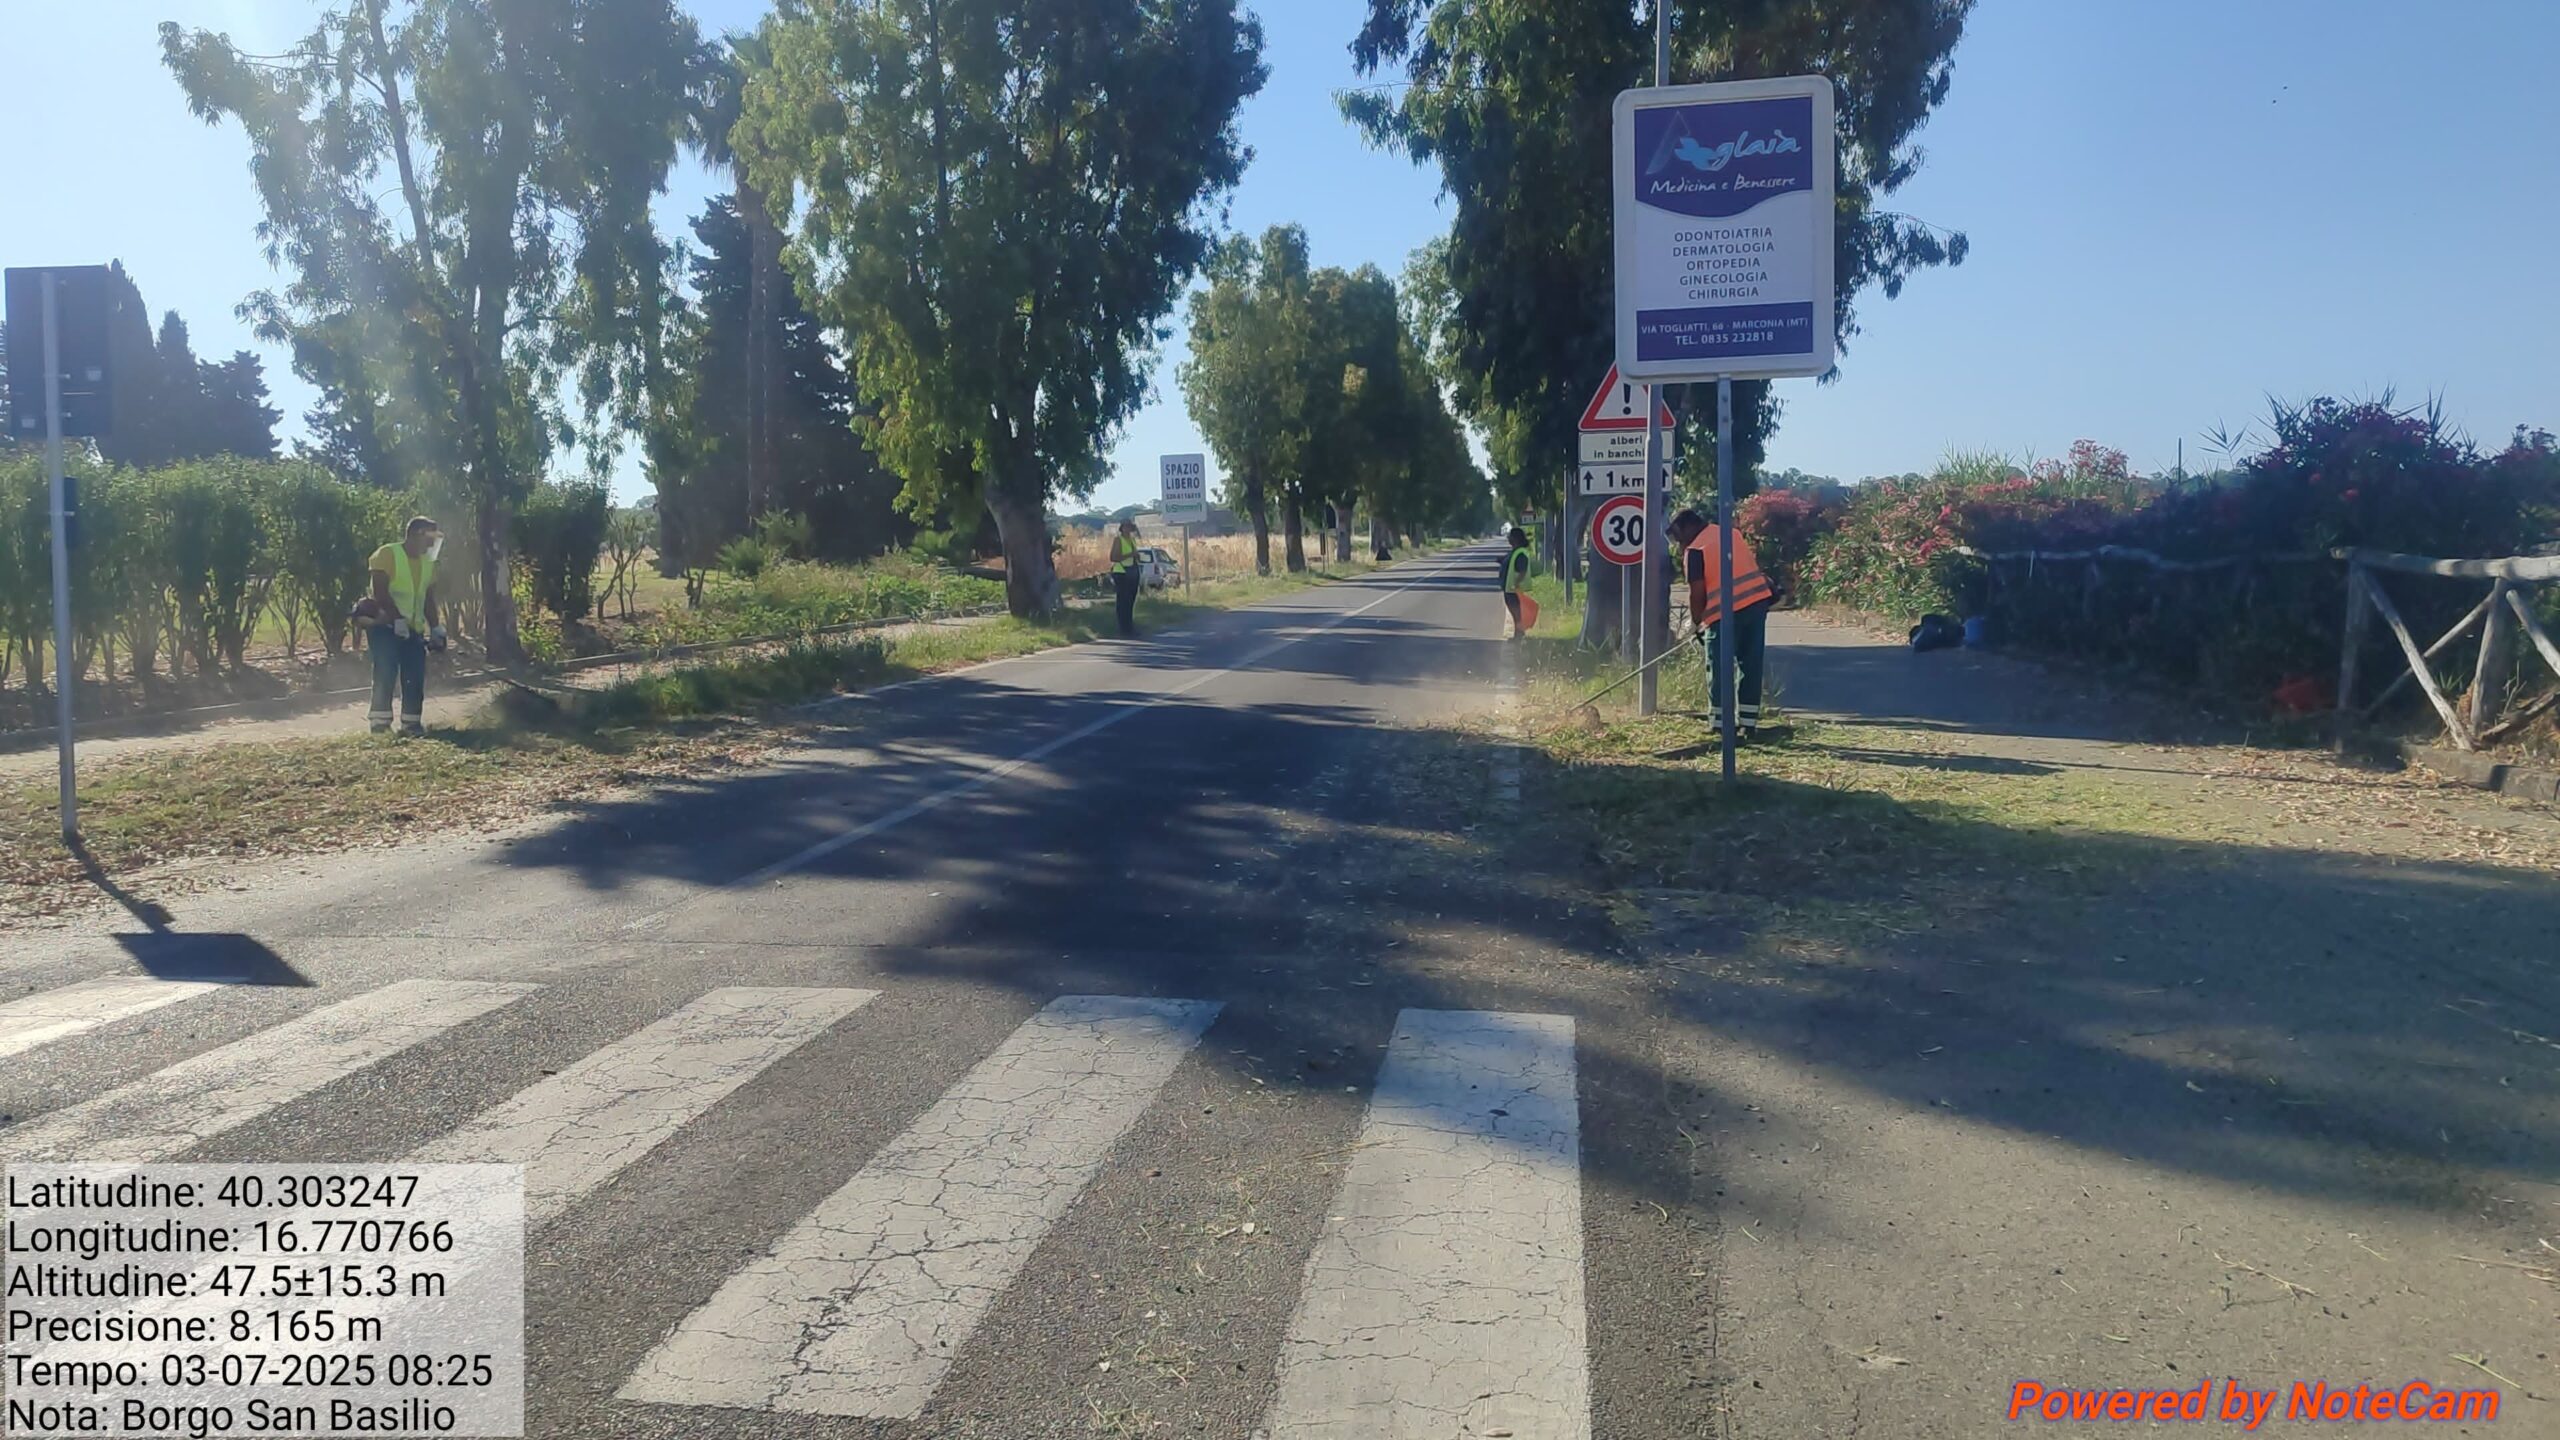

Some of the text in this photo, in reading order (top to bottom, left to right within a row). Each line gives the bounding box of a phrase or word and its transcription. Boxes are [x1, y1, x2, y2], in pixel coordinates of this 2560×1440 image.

[1651, 174, 1796, 194] Medicina e Benessere
[1674, 227, 1773, 242] ODONTOIATRIA
[1673, 242, 1775, 257] DERMATOLOGIA
[1686, 257, 1761, 271] ORTOPEDIA
[1680, 271, 1768, 286] GINECOLOGIA
[1688, 286, 1759, 300] CHIRURGIA
[1641, 325, 1657, 334] VIA
[1732, 319, 1784, 329] MARCONIA
[1786, 317, 1809, 327] (MT)
[1675, 331, 1774, 346] TEL. 0835 232818
[1610, 435, 1643, 446] alberi
[1594, 448, 1646, 459] in banchi
[1165, 463, 1200, 476] SPAZIO
[1166, 477, 1200, 490] LIBERO
[1606, 471, 1645, 488] 1 km
[1608, 515, 1643, 547] 30
